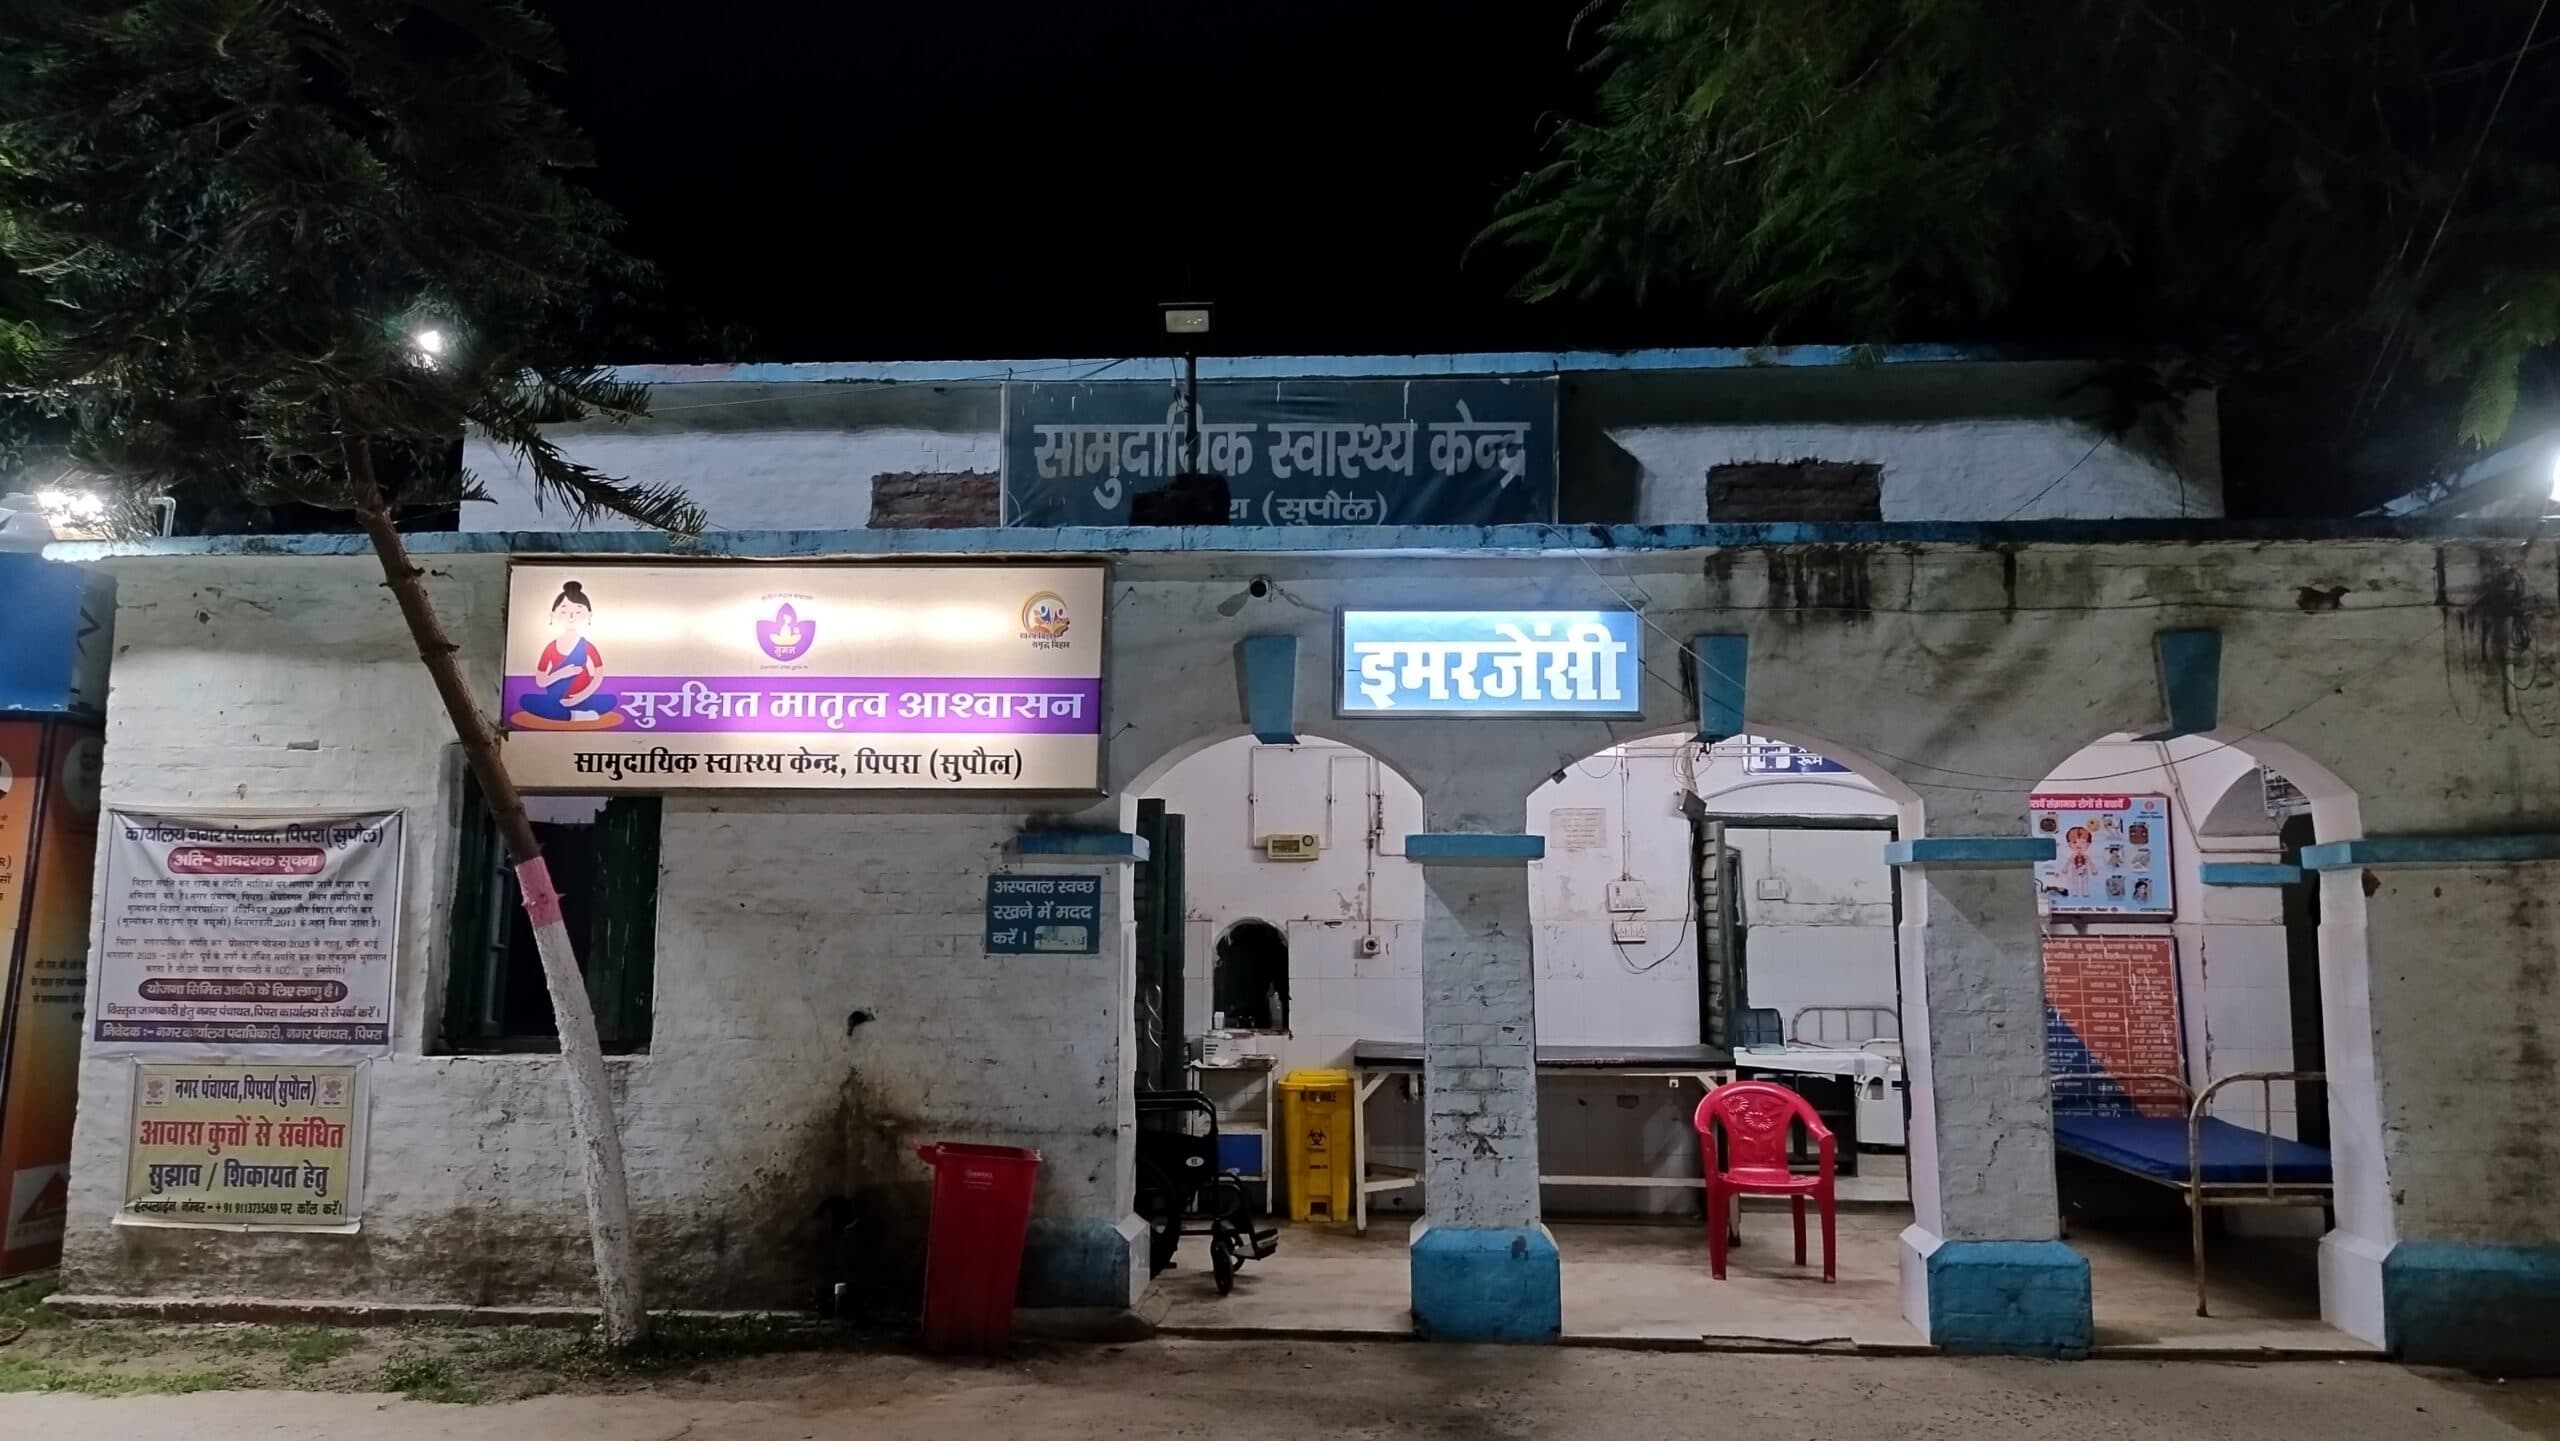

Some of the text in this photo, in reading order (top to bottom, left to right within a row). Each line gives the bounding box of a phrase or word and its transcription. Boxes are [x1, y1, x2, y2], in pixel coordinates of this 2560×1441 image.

[1269, 422, 1418, 480] स्वास्थ्य
[1429, 401, 1531, 488] केन्द्र
[1354, 622, 1627, 710] इमरजेंसी
[620, 681, 1085, 730] सुरक्षित मातृत्व आश्वासन
[573, 746, 699, 782] सामुदायिक
[788, 745, 846, 778] केन्द्र,
[854, 746, 922, 776] पिपरा
[929, 746, 1023, 782] (सुपौल)
[125, 822, 185, 843] कार्यालय
[214, 854, 275, 868] आवश्यक
[279, 854, 319, 873] सूचना
[993, 880, 1095, 894] अस्पताल स्वच्छ
[993, 901, 1094, 920] रखने में मदद
[146, 982, 185, 995] योजना
[224, 981, 255, 996] अवधि
[257, 982, 270, 996] के
[272, 983, 296, 997] लिए
[107, 1002, 136, 1018] विस्तृत
[137, 1003, 178, 1016] जानकारी
[179, 1004, 194, 1020] हेतु
[280, 1004, 318, 1018] कार्यालय
[182, 1024, 225, 1039] कार्यालय
[354, 1026, 384, 1040] पिपरा
[175, 1079, 199, 1099] नगर
[140, 1115, 346, 1156] आवारा कुत्तों से संबंधित
[149, 1164, 203, 1195] सुझाव
[223, 1158, 299, 1189] शिकायत
[303, 1159, 329, 1198] हेतु
[280, 1202, 293, 1215] पर
[297, 1200, 318, 1215] कॉल
